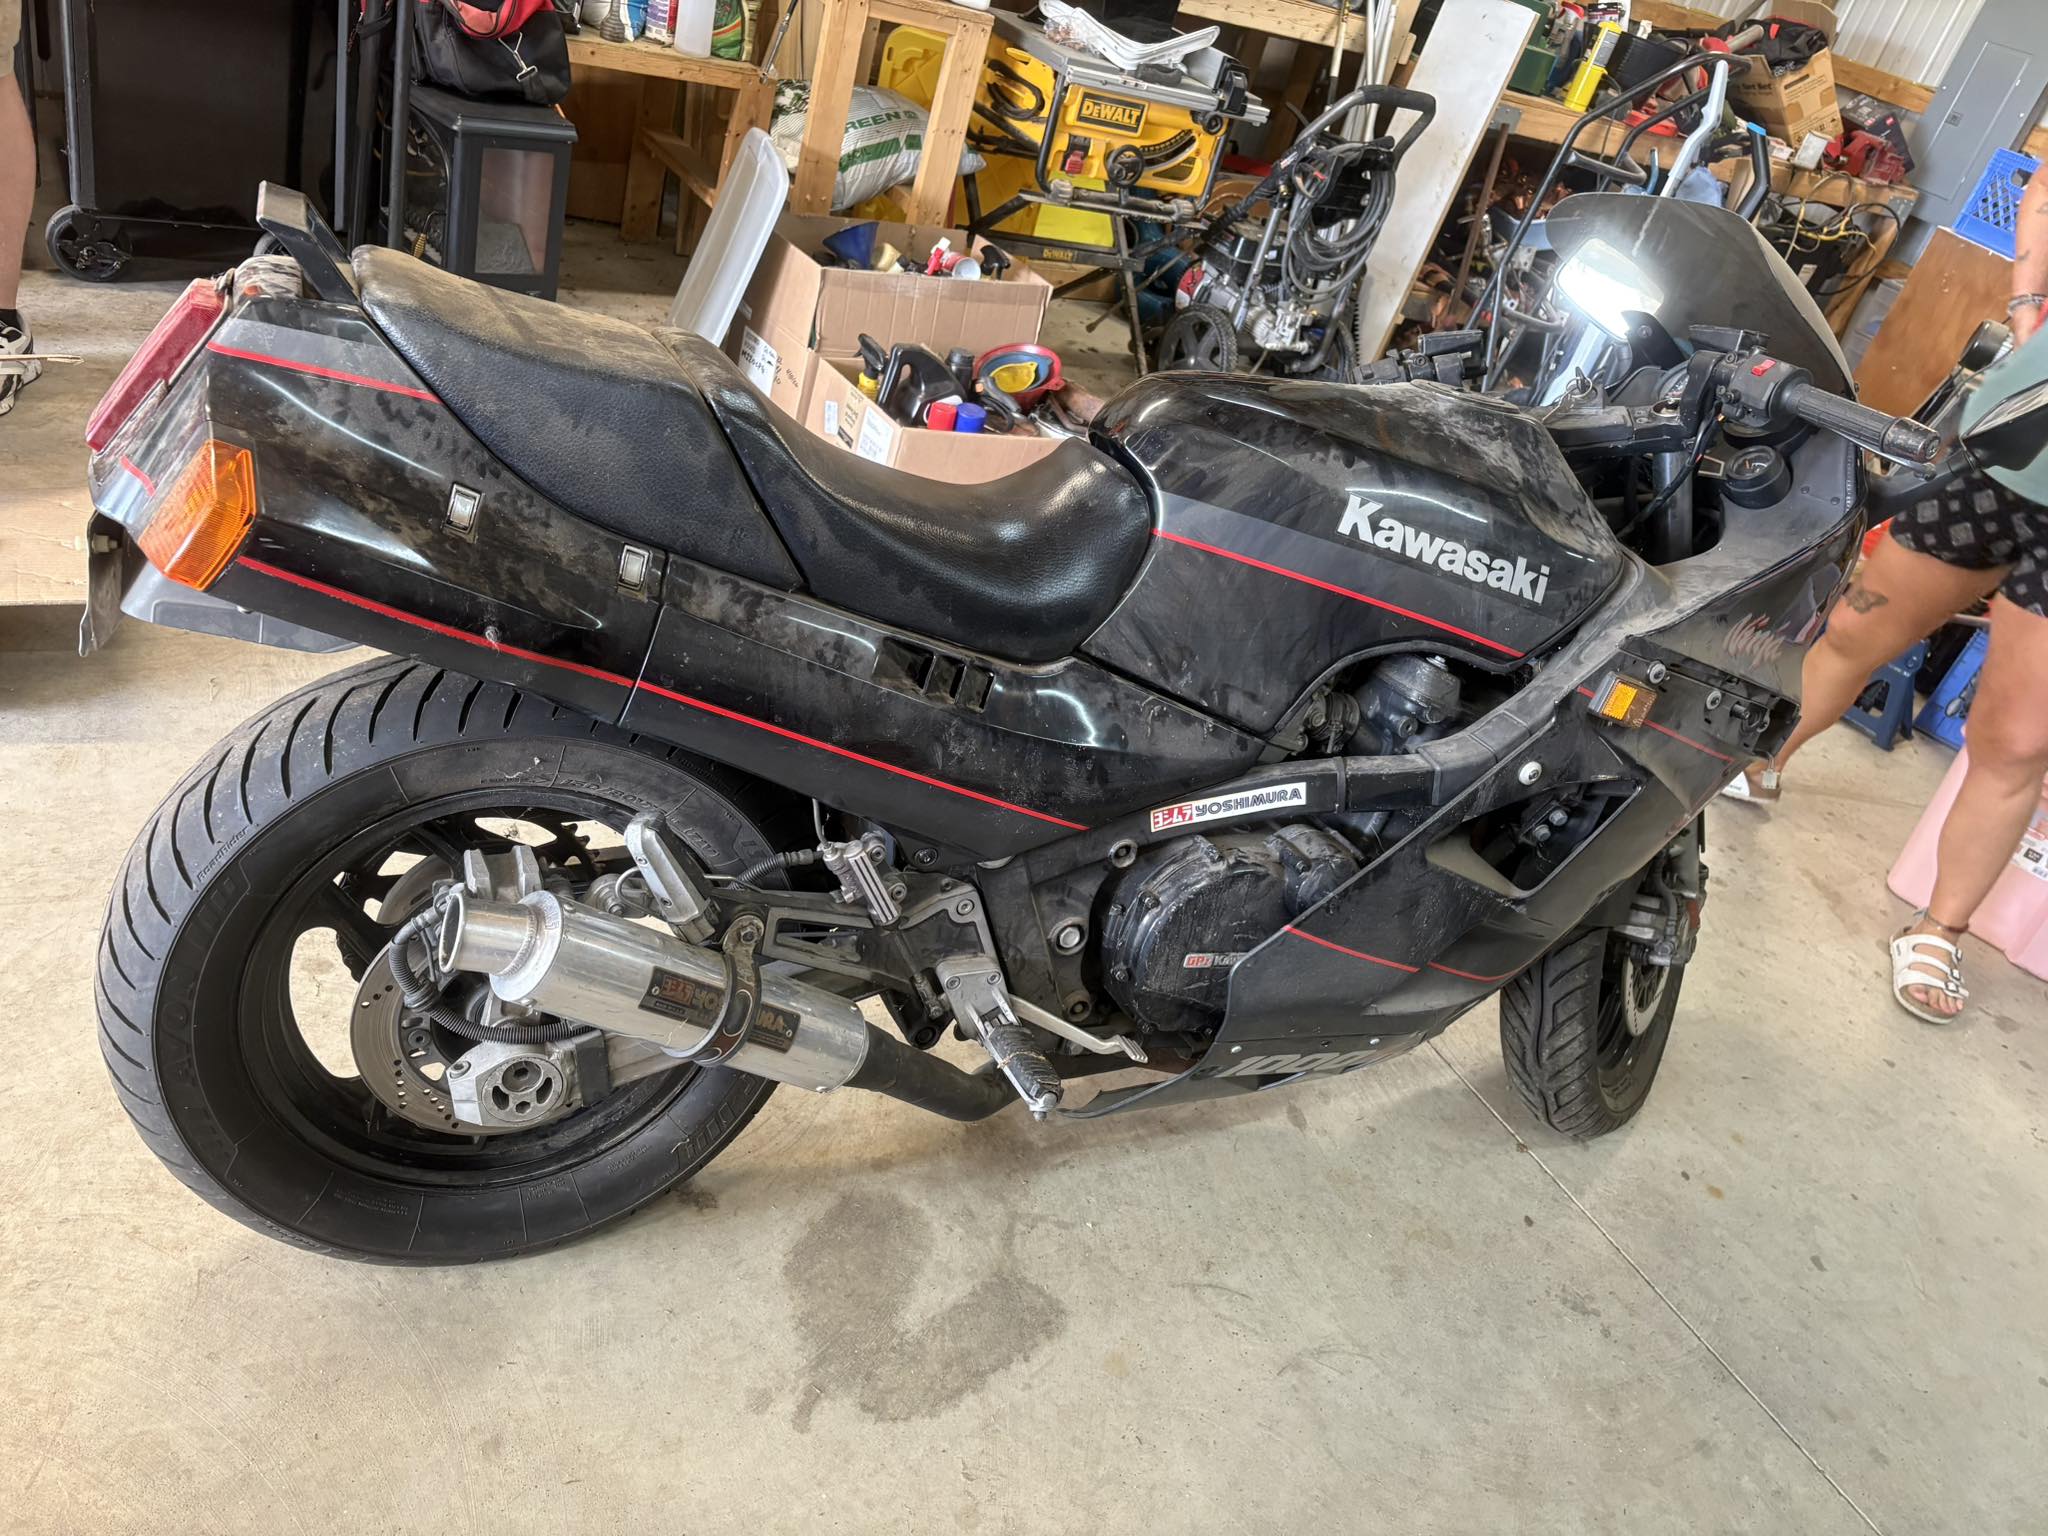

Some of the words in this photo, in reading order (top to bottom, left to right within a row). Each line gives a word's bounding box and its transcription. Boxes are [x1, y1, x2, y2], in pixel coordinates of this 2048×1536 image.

[845, 110, 901, 134] REEN
[1337, 494, 1550, 604] Kawasaki
[1153, 804, 1193, 829] ヨシムラ
[1194, 787, 1303, 817] YOSHIMURA
